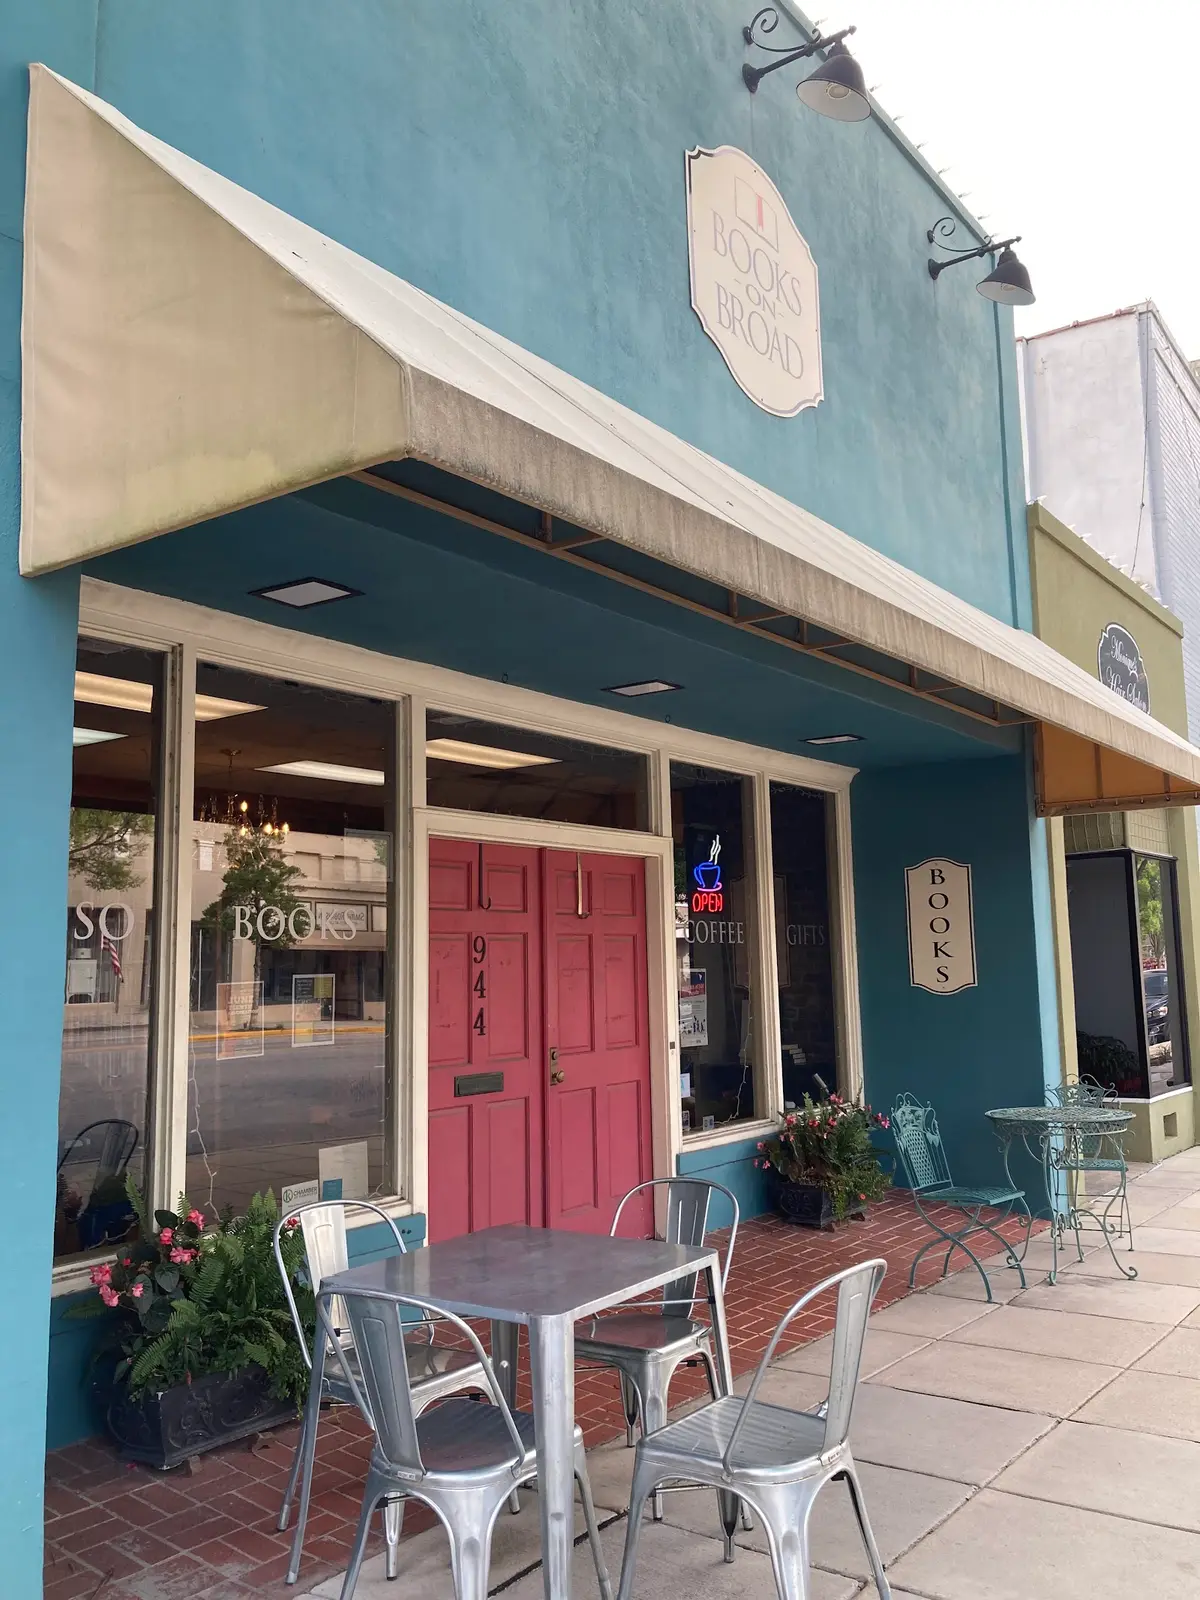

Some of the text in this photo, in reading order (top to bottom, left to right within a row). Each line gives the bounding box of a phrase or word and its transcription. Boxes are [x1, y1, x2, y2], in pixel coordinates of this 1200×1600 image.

[711, 208, 802, 317] BOOKS
[715, 281, 804, 379] BROAD
[73, 901, 359, 941] SO BOOKS
[683, 919, 745, 944] COFFEE
[692, 892, 723, 913] OPEN
[787, 924, 825, 946] GIFTS
[928, 868, 955, 984] BOOKS
[473, 935, 487, 1036] 944
